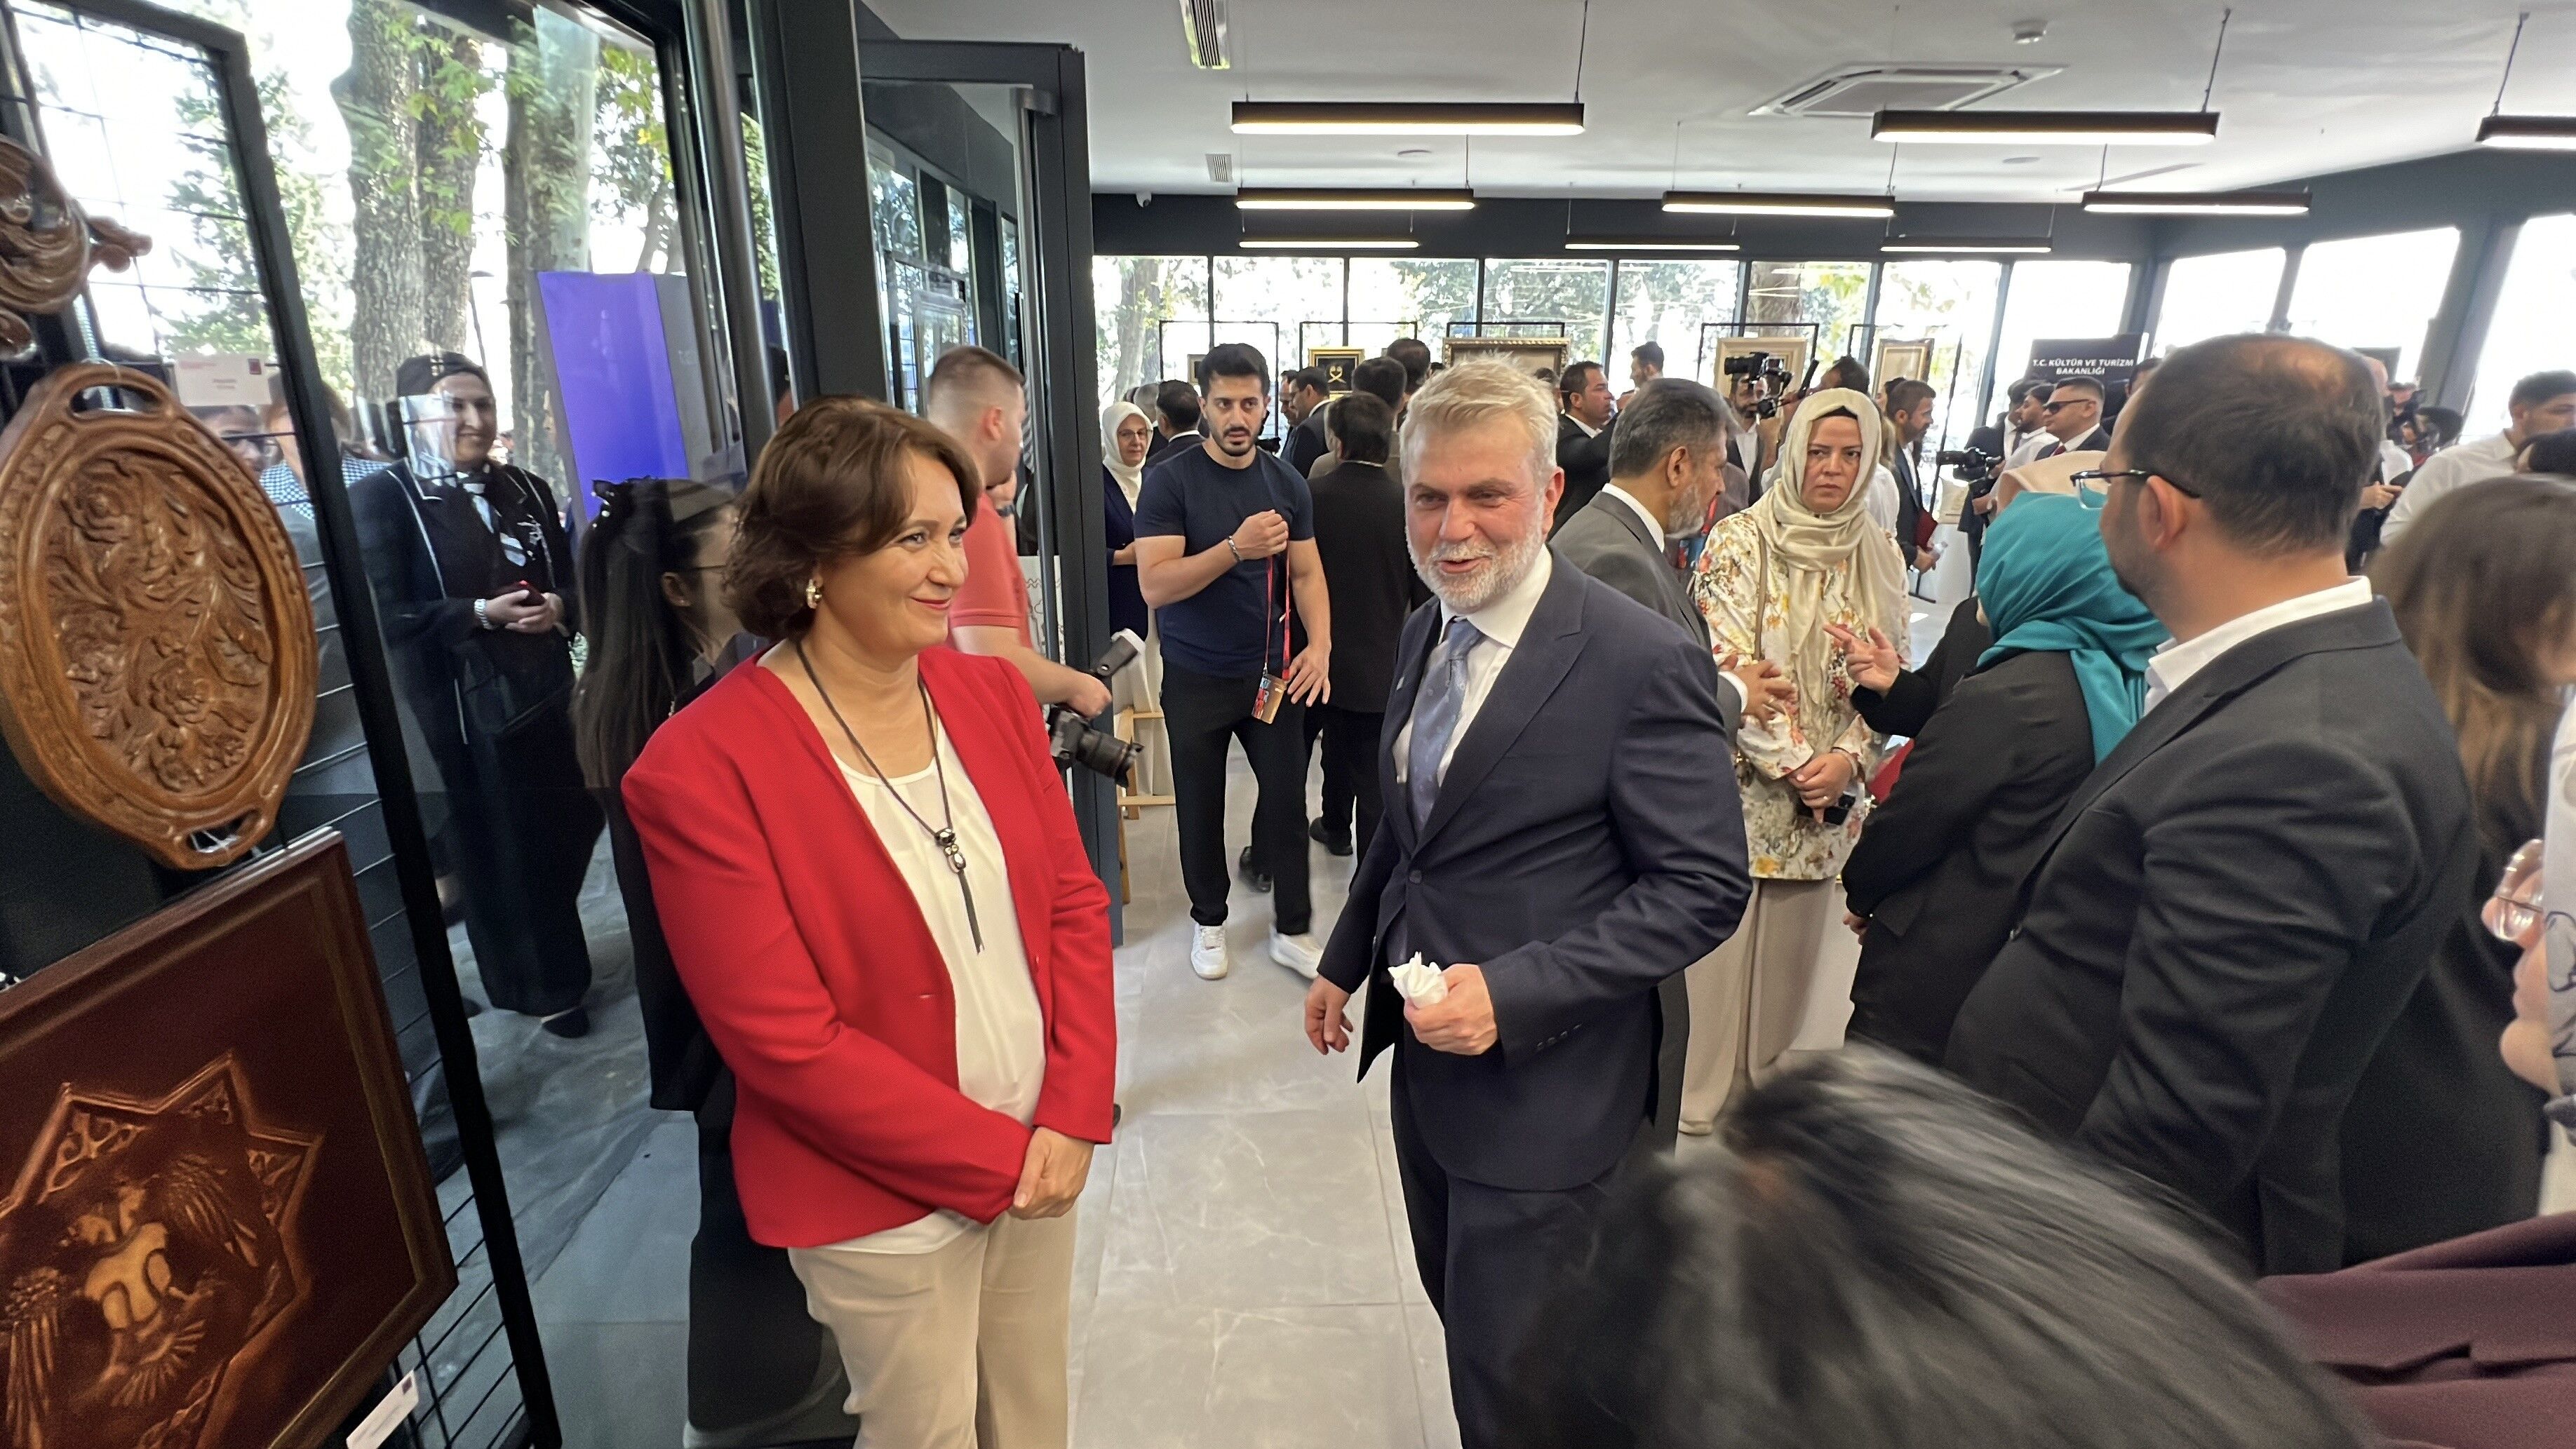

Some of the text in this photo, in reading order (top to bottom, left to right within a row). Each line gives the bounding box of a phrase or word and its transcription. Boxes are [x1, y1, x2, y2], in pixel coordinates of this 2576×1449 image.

[2048, 358, 2083, 367] KÜLTÜR
[2085, 358, 2097, 367] VE
[2099, 358, 2134, 367] TURİZM
[2056, 367, 2105, 375] BAKANLIĞI
